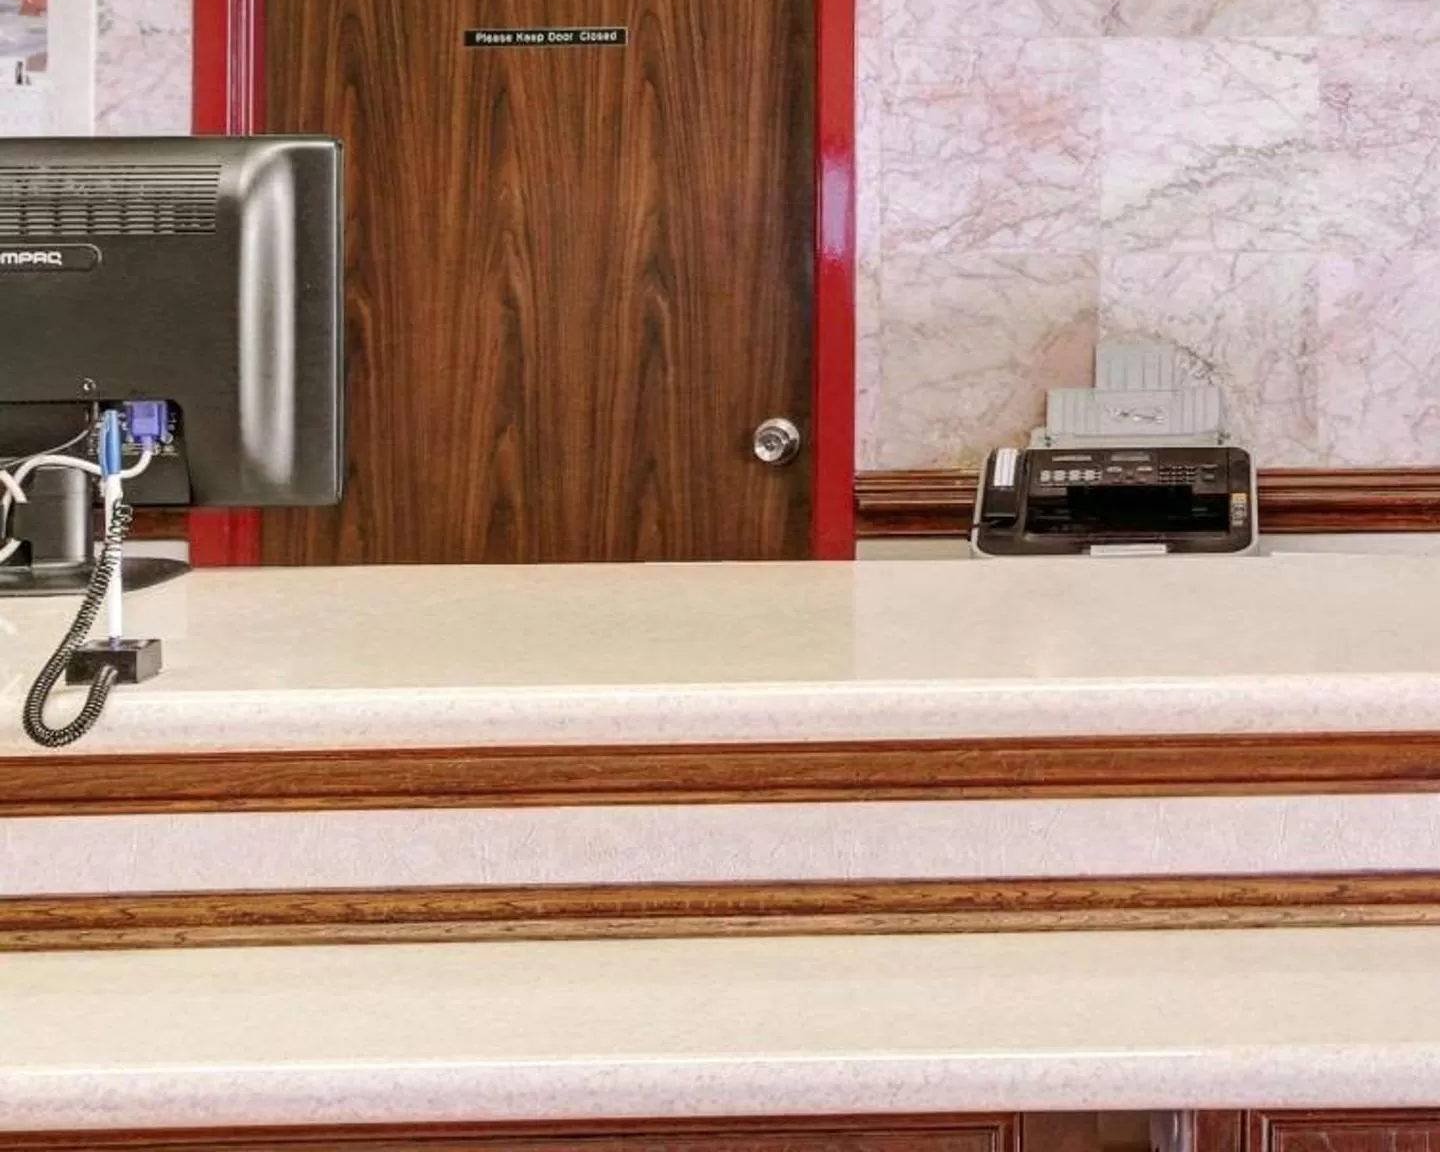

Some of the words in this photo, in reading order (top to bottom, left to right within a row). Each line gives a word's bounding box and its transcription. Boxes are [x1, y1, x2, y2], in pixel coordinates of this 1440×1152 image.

[475, 32, 513, 44] Please
[515, 32, 545, 43] Keep
[548, 31, 573, 42] Door
[579, 30, 618, 42] Closed
[0, 251, 62, 265] MPAQ
